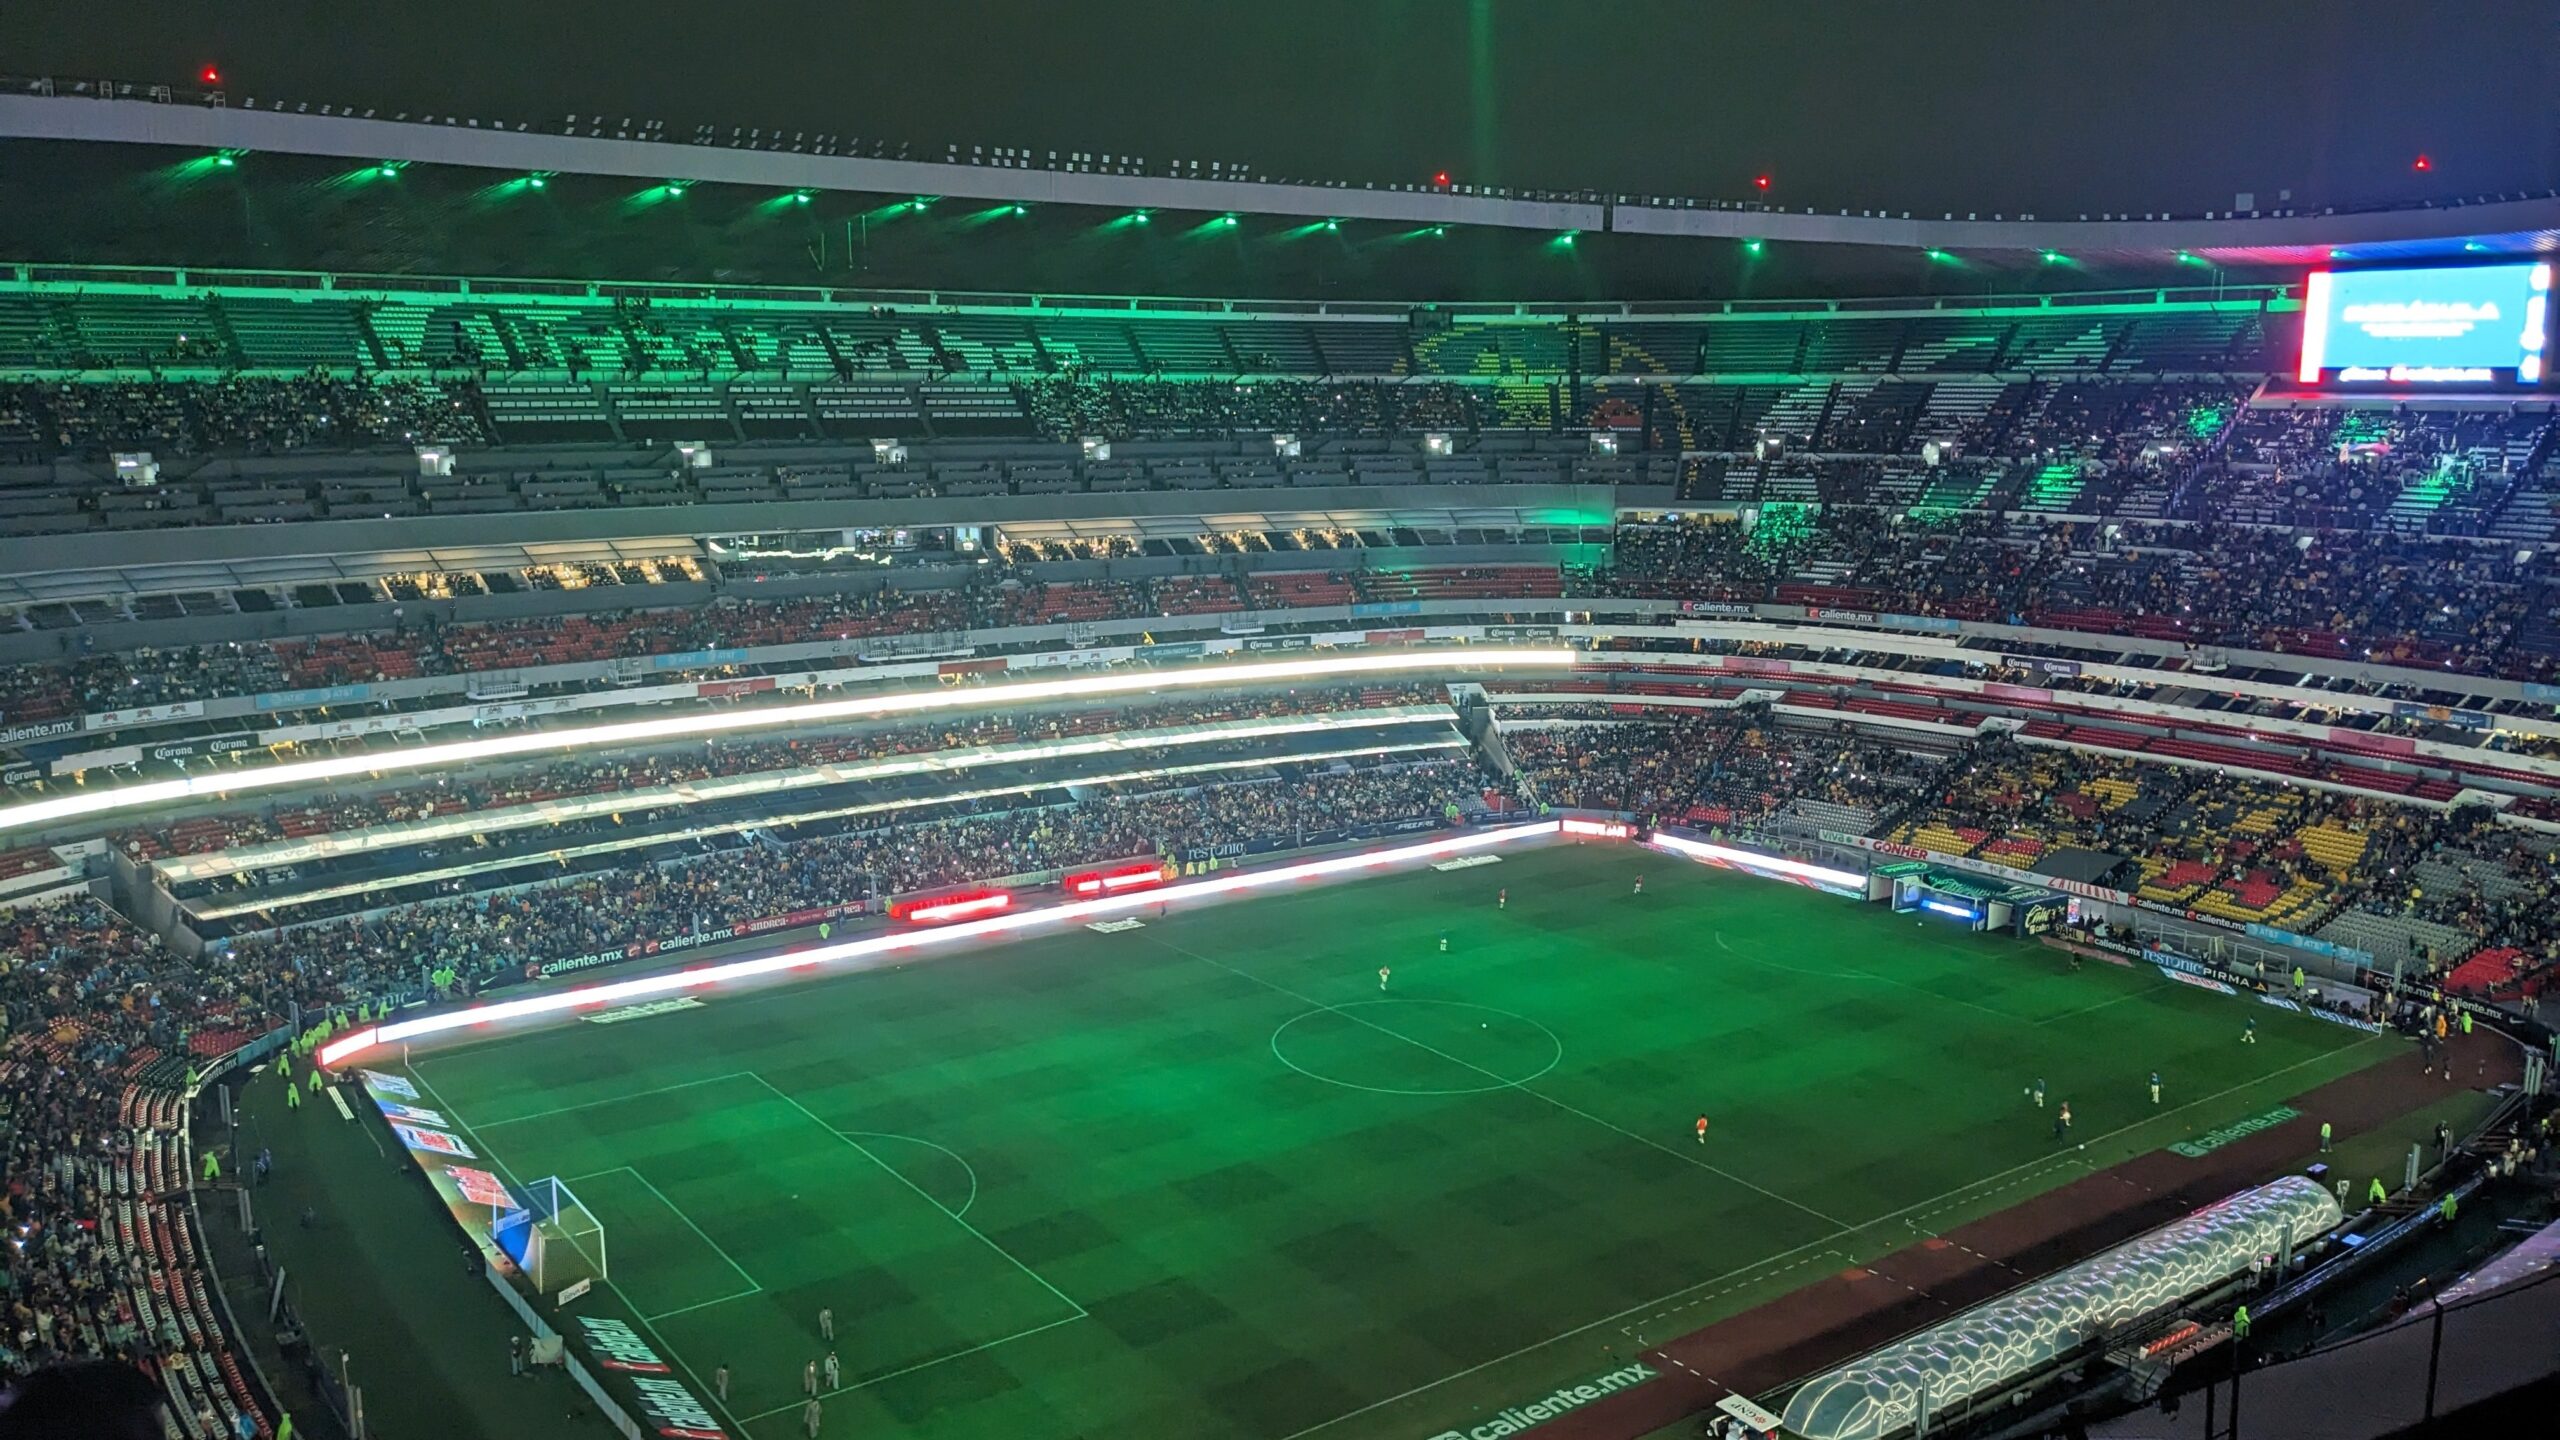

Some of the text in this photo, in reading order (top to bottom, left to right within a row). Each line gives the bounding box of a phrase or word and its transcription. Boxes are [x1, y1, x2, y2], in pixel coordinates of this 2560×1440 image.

[1692, 602, 1750, 614] caliente.mx
[1818, 608, 1873, 623] caliente.mx
[0, 721, 74, 743] aliente.mx
[154, 746, 193, 760] Corona
[211, 739, 248, 753] Corona
[4, 769, 41, 785] Corona
[1872, 840, 1928, 860] GONHER
[2136, 898, 2186, 918] caliente.mx
[2195, 911, 2246, 932] caliente.mx
[660, 925, 733, 951] caliente.mx
[2094, 937, 2141, 957] caliente.mx
[541, 948, 623, 975] caliente.mx
[2203, 967, 2250, 988] PIRMA
[2374, 976, 2432, 999] cante.mx
[2444, 995, 2503, 1020] caliente.mx
[1470, 1362, 1657, 1440] caliente.mx
[1731, 1402, 1757, 1418] GNP
